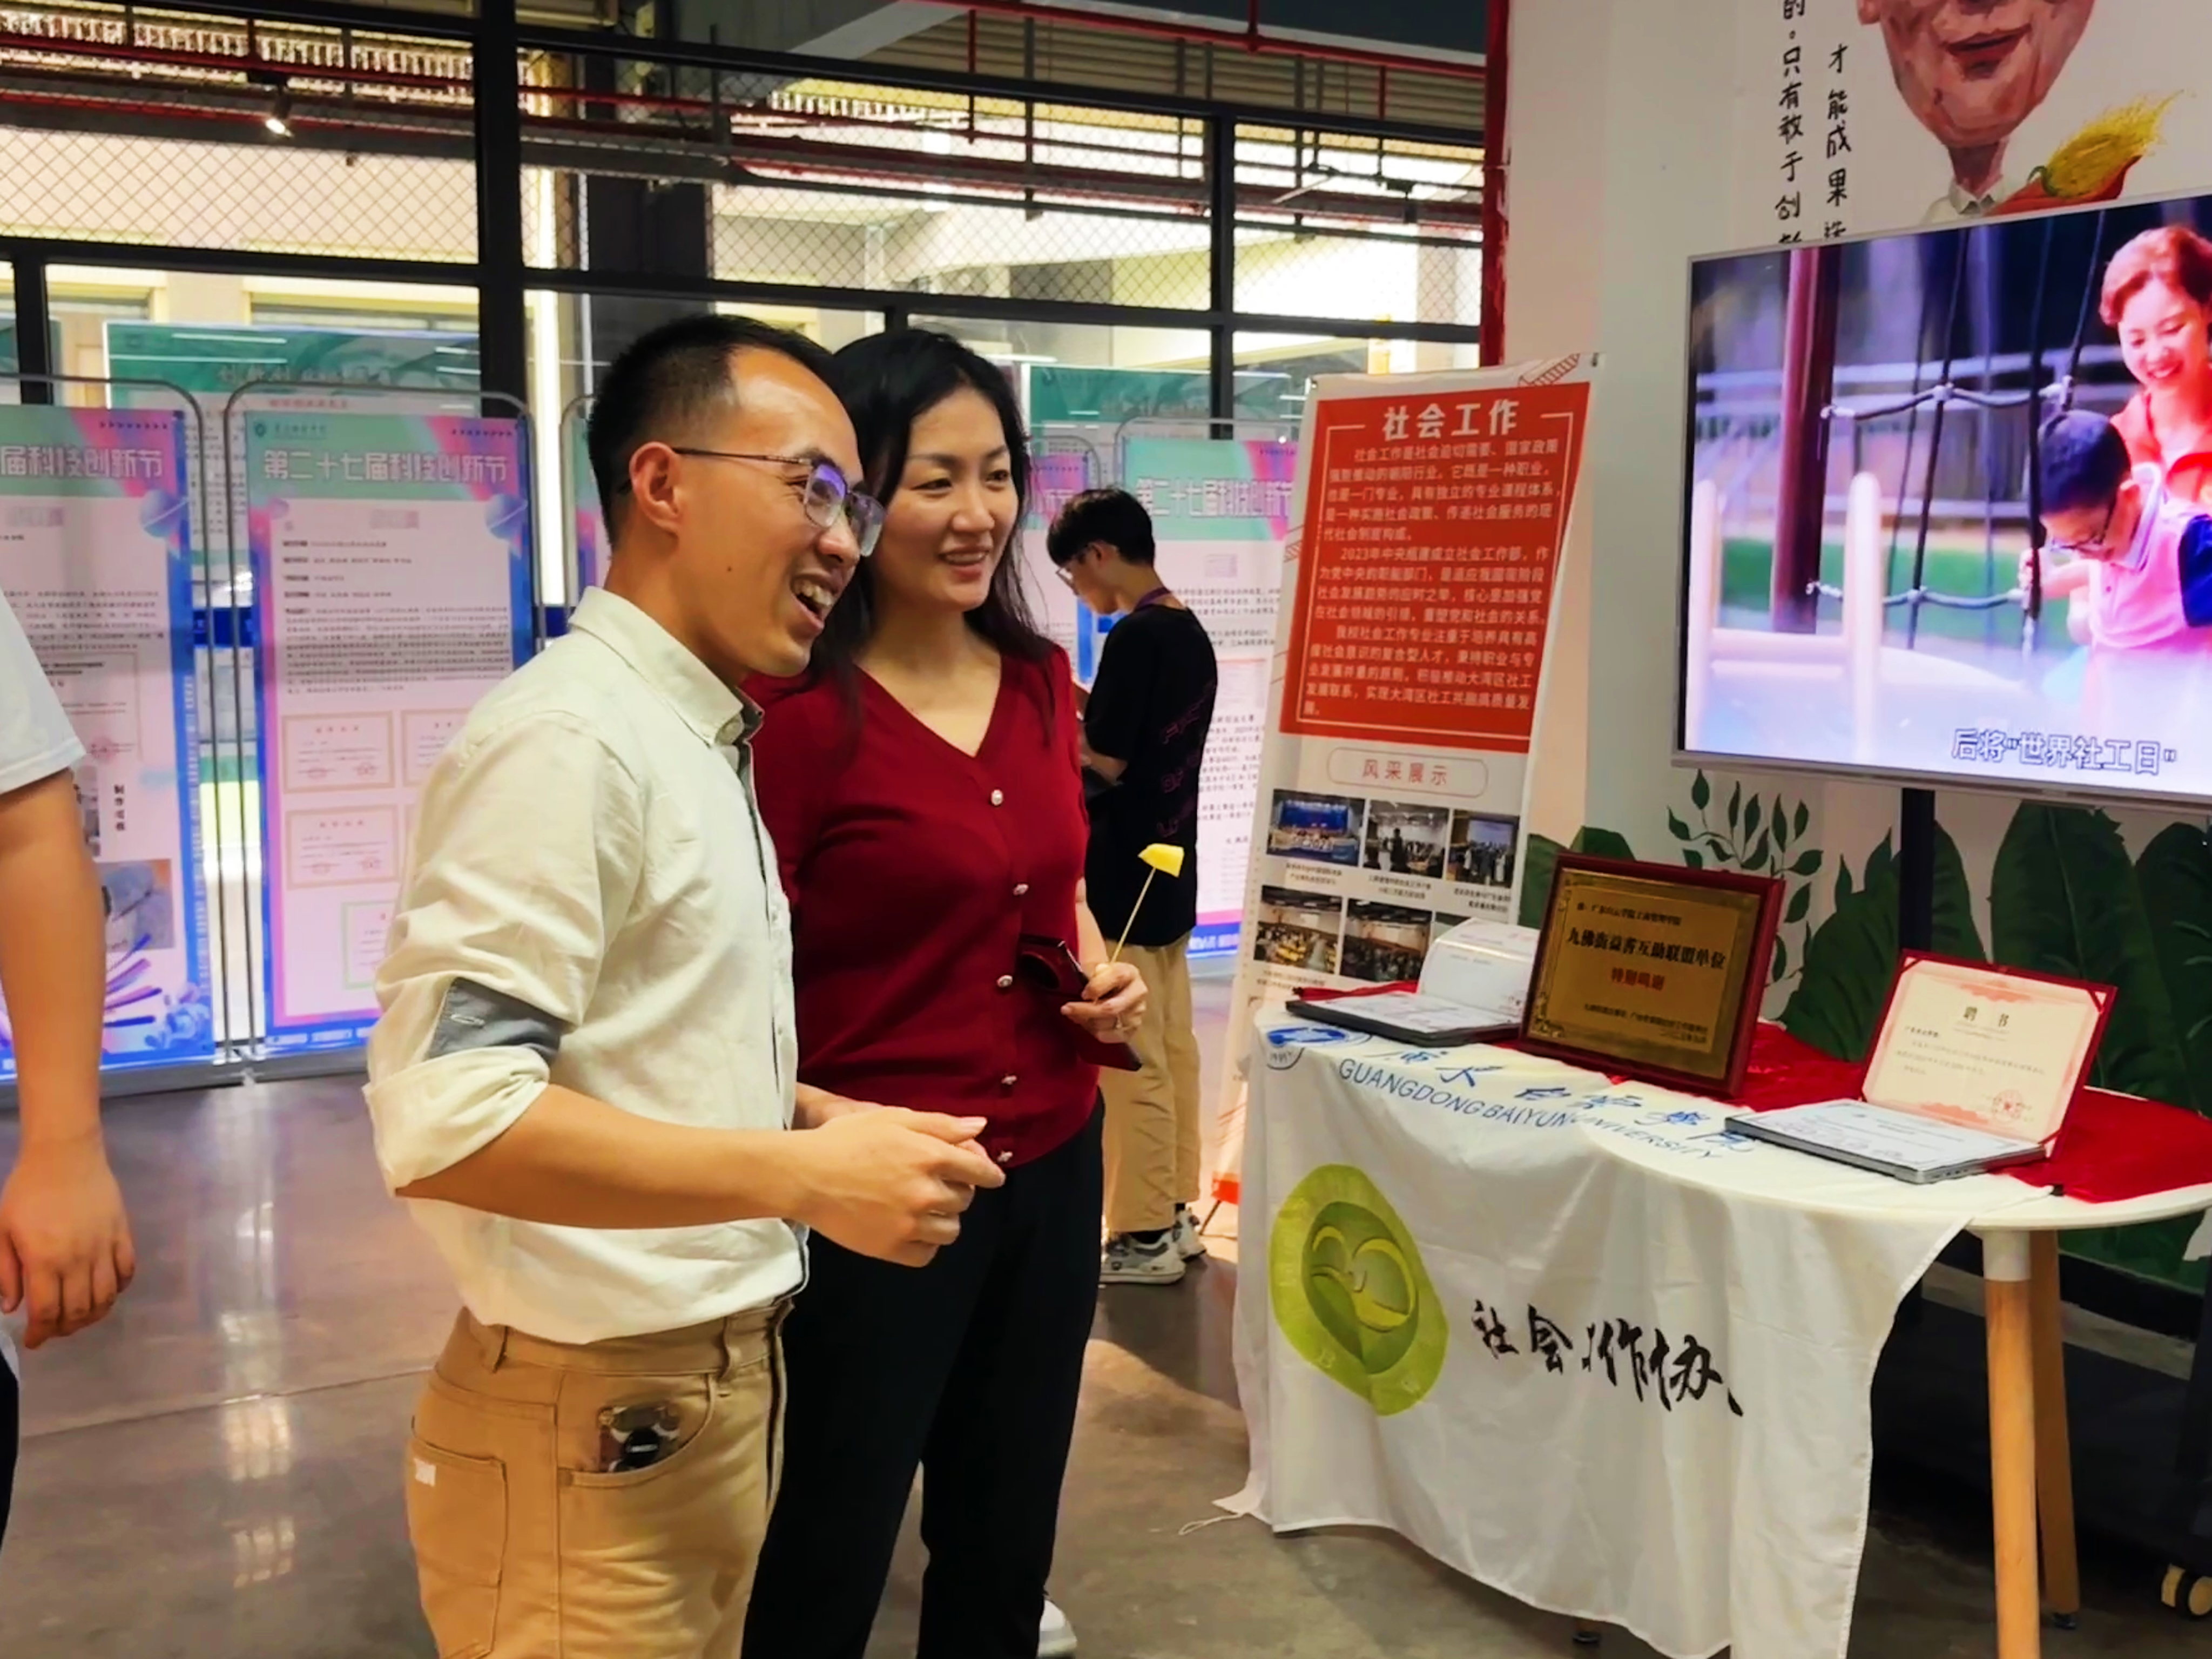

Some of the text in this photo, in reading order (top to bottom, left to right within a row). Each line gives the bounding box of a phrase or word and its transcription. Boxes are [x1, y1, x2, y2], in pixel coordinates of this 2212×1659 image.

[1382, 399, 1520, 441] 社会工作
[264, 449, 508, 483] 第二十七届科技创新节
[1362, 759, 1449, 785] 风采展示
[1339, 1058, 1480, 1114] GUANGDONG
